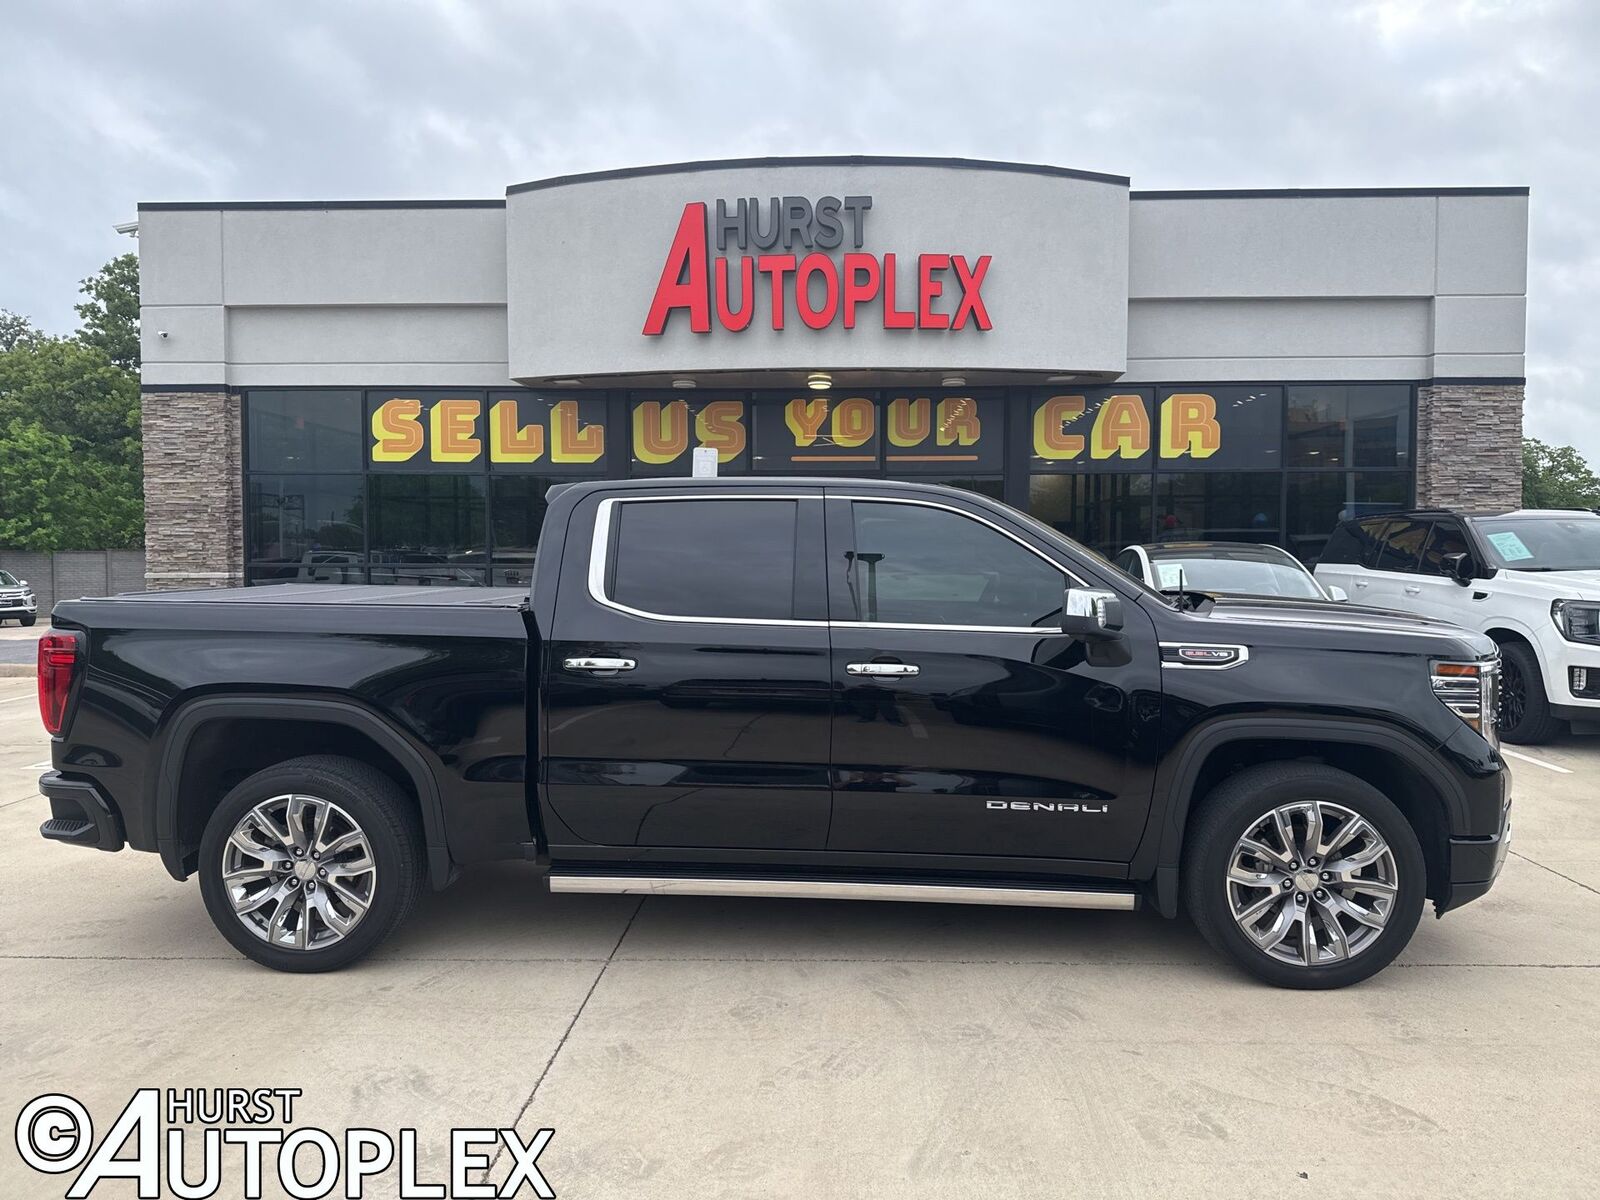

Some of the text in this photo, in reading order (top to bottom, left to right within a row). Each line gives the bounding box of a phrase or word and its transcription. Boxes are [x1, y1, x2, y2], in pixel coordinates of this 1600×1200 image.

[716, 195, 873, 250] HURST
[642, 201, 993, 336] AUTOPLEX
[371, 393, 1222, 465] SELL US YOUR CAR
[986, 800, 1109, 814] DENALI
